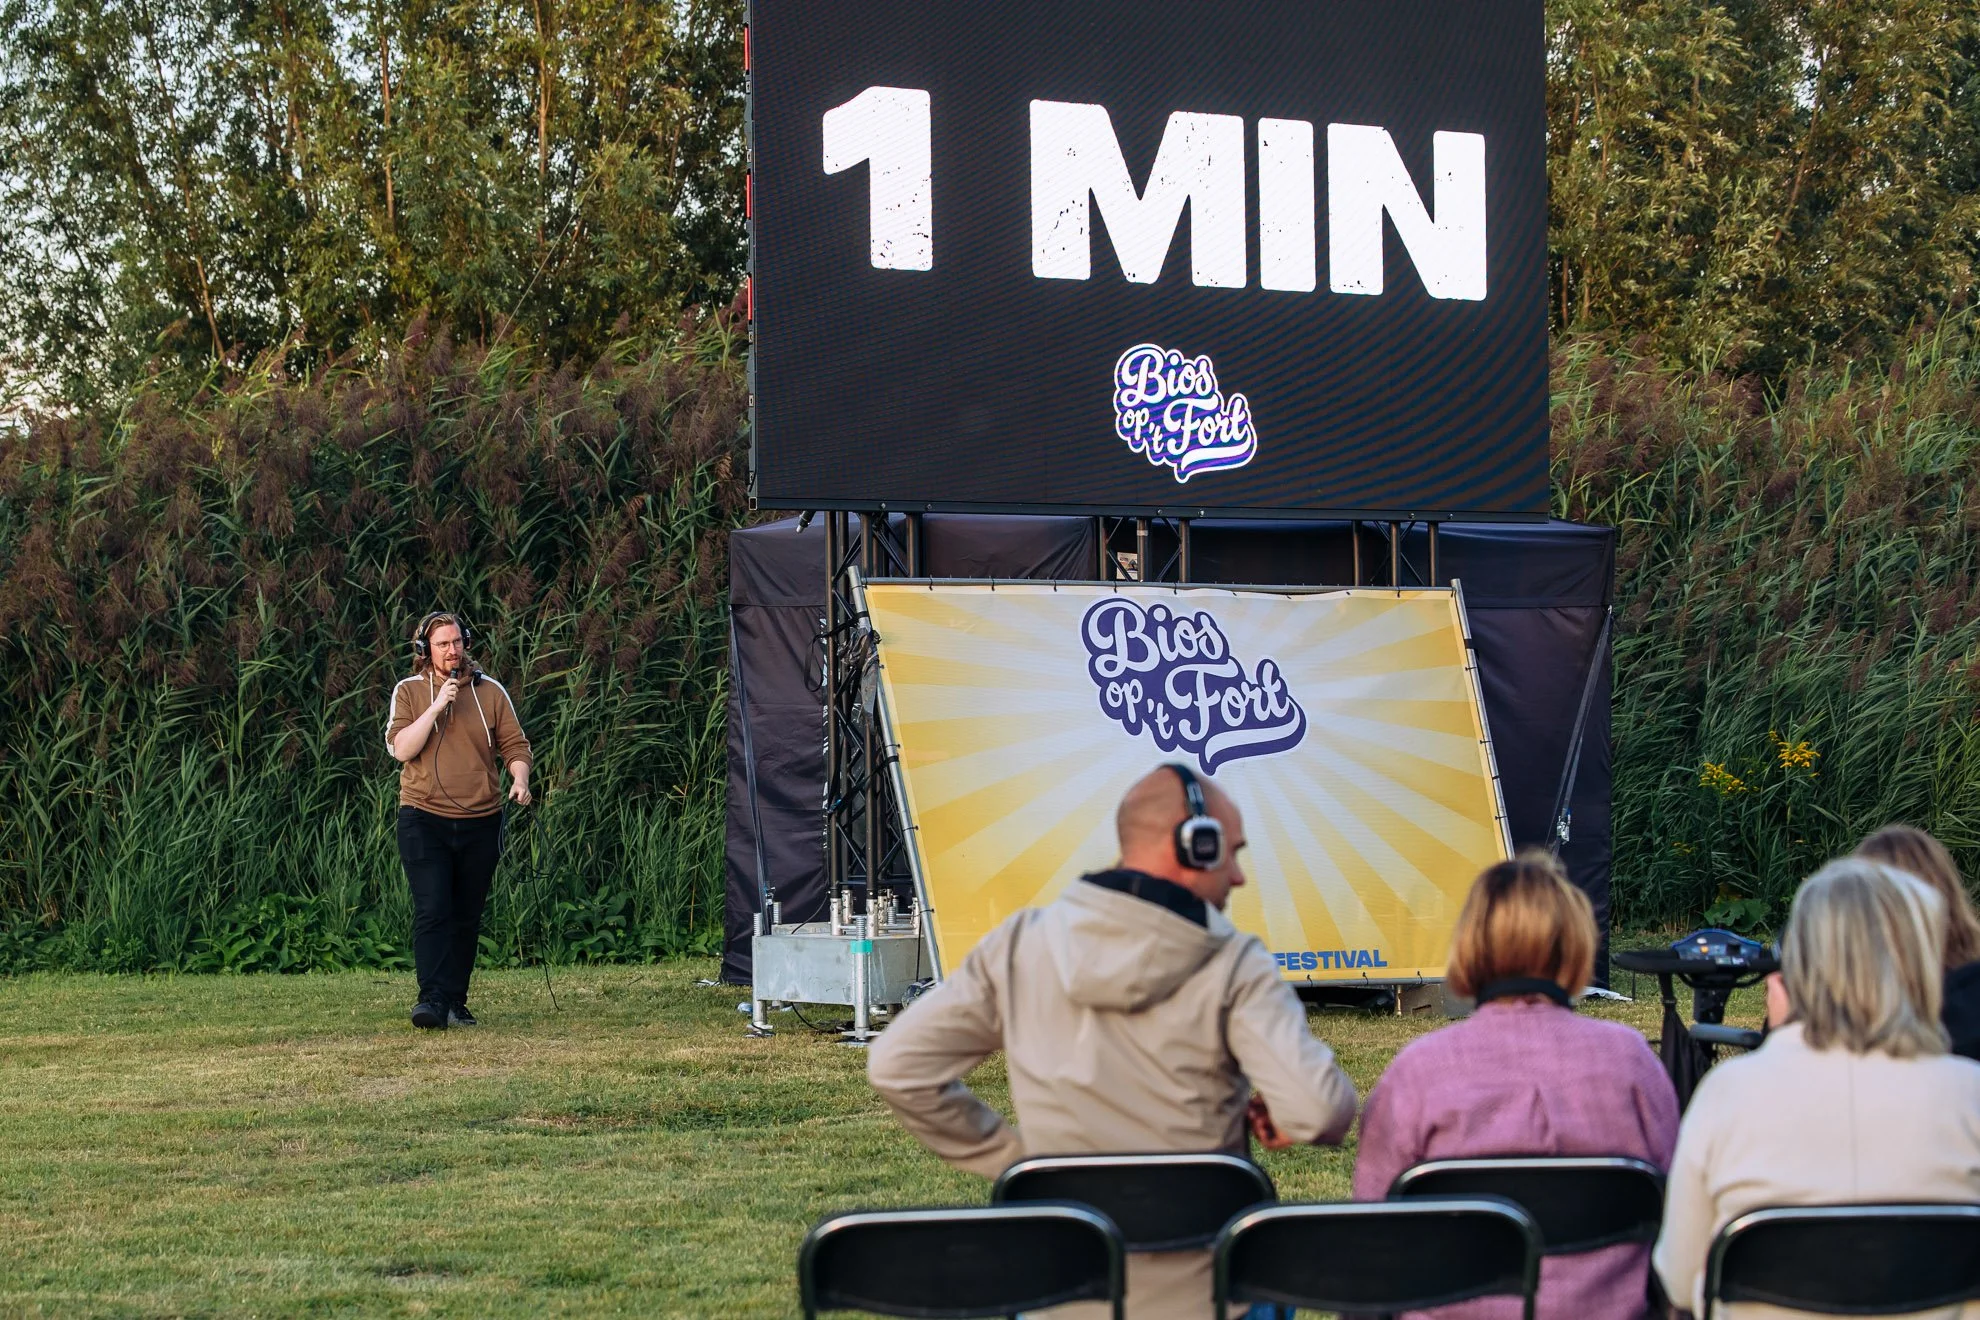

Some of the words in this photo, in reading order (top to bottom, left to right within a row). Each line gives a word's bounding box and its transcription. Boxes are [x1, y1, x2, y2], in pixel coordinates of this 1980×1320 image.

[823, 86, 933, 271] 1
[1030, 99, 1487, 301] MIN
[1121, 349, 1212, 407] Bios
[1123, 408, 1149, 440] op
[1164, 394, 1248, 455] Fort
[1088, 601, 1224, 678] Bios
[1106, 679, 1143, 724] op
[1165, 659, 1292, 743] Fort
